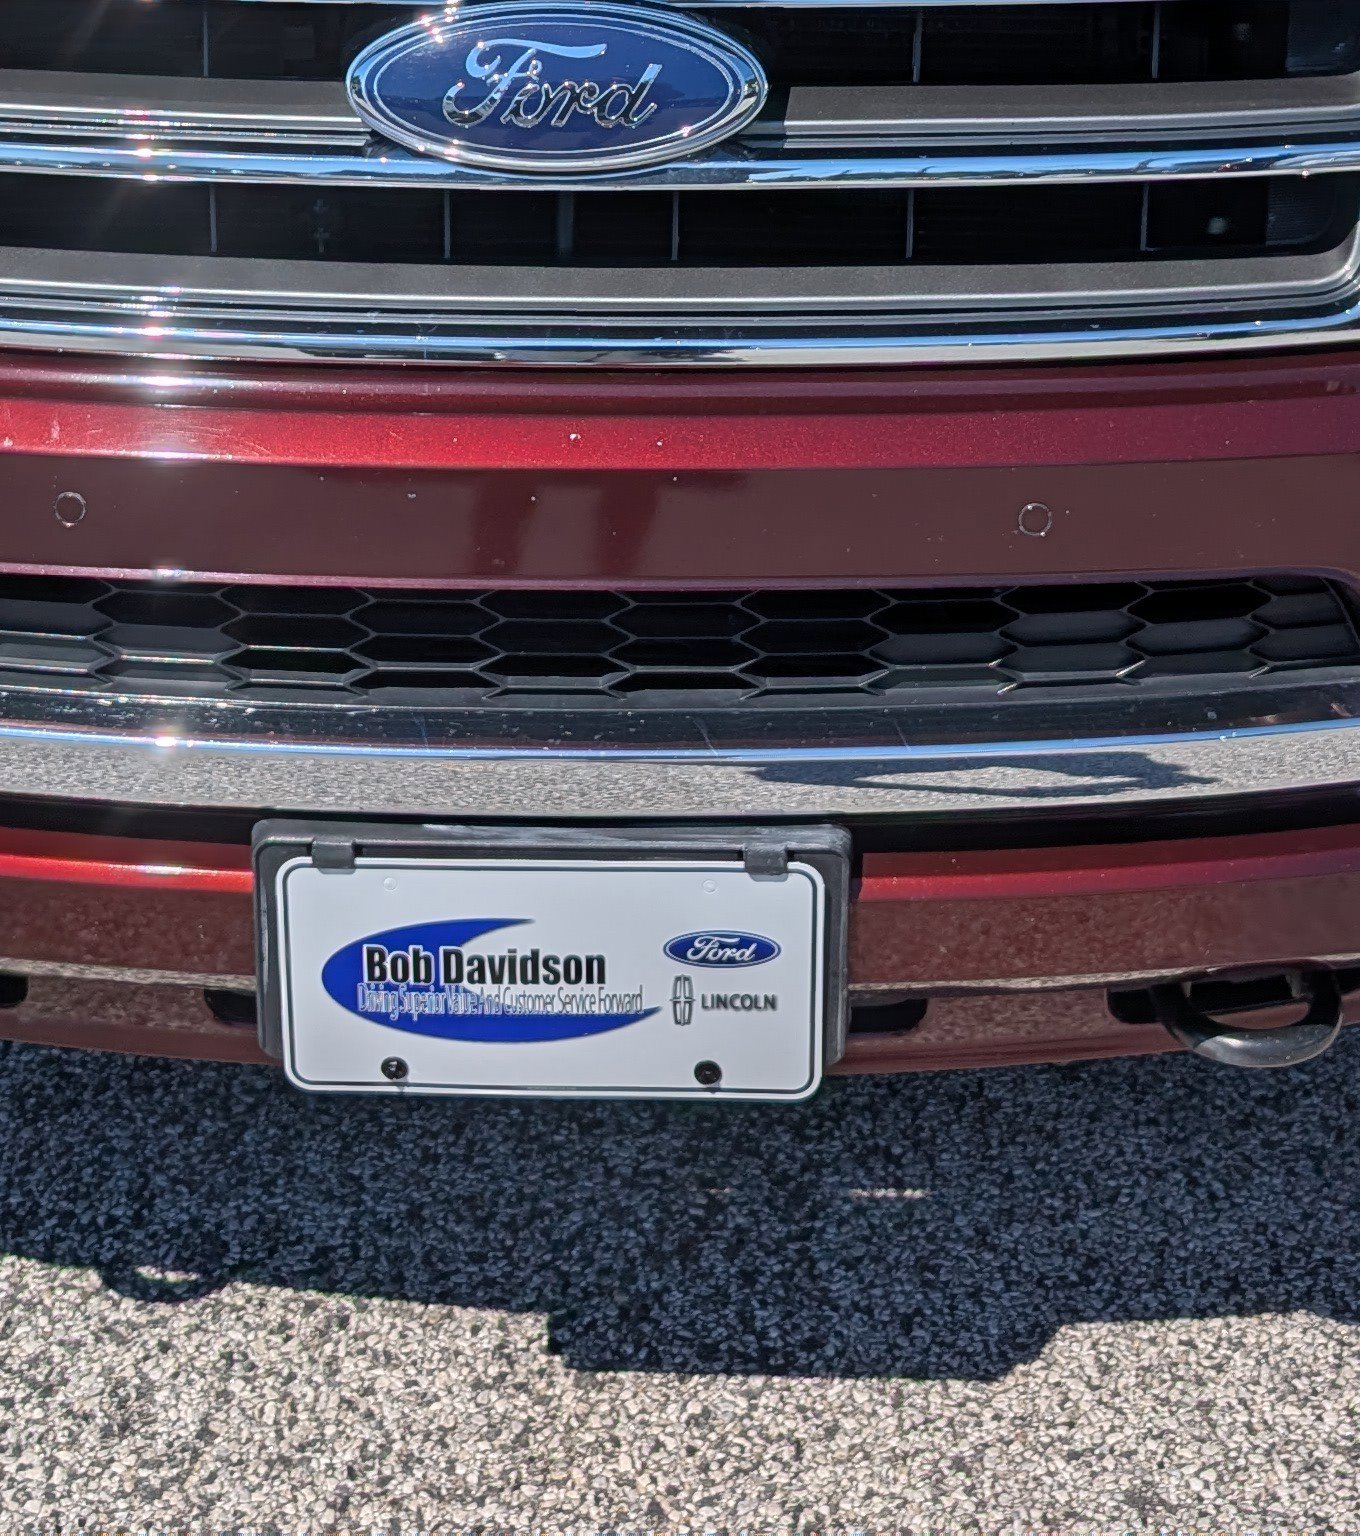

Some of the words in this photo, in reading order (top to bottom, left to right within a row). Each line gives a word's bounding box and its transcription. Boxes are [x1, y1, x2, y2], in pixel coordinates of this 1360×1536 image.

[442, 37, 663, 128] Ford
[364, 944, 435, 985] Bob
[441, 946, 607, 986] Davidson
[686, 935, 758, 962] Ford
[357, 982, 400, 1021] Driving
[398, 983, 446, 1022] Superior
[444, 984, 482, 1015] Value
[479, 984, 502, 1015] And
[502, 985, 556, 1015] Customer
[557, 985, 597, 1015] Service
[597, 983, 644, 1015] Forward
[701, 993, 777, 1012] LINCOLN
